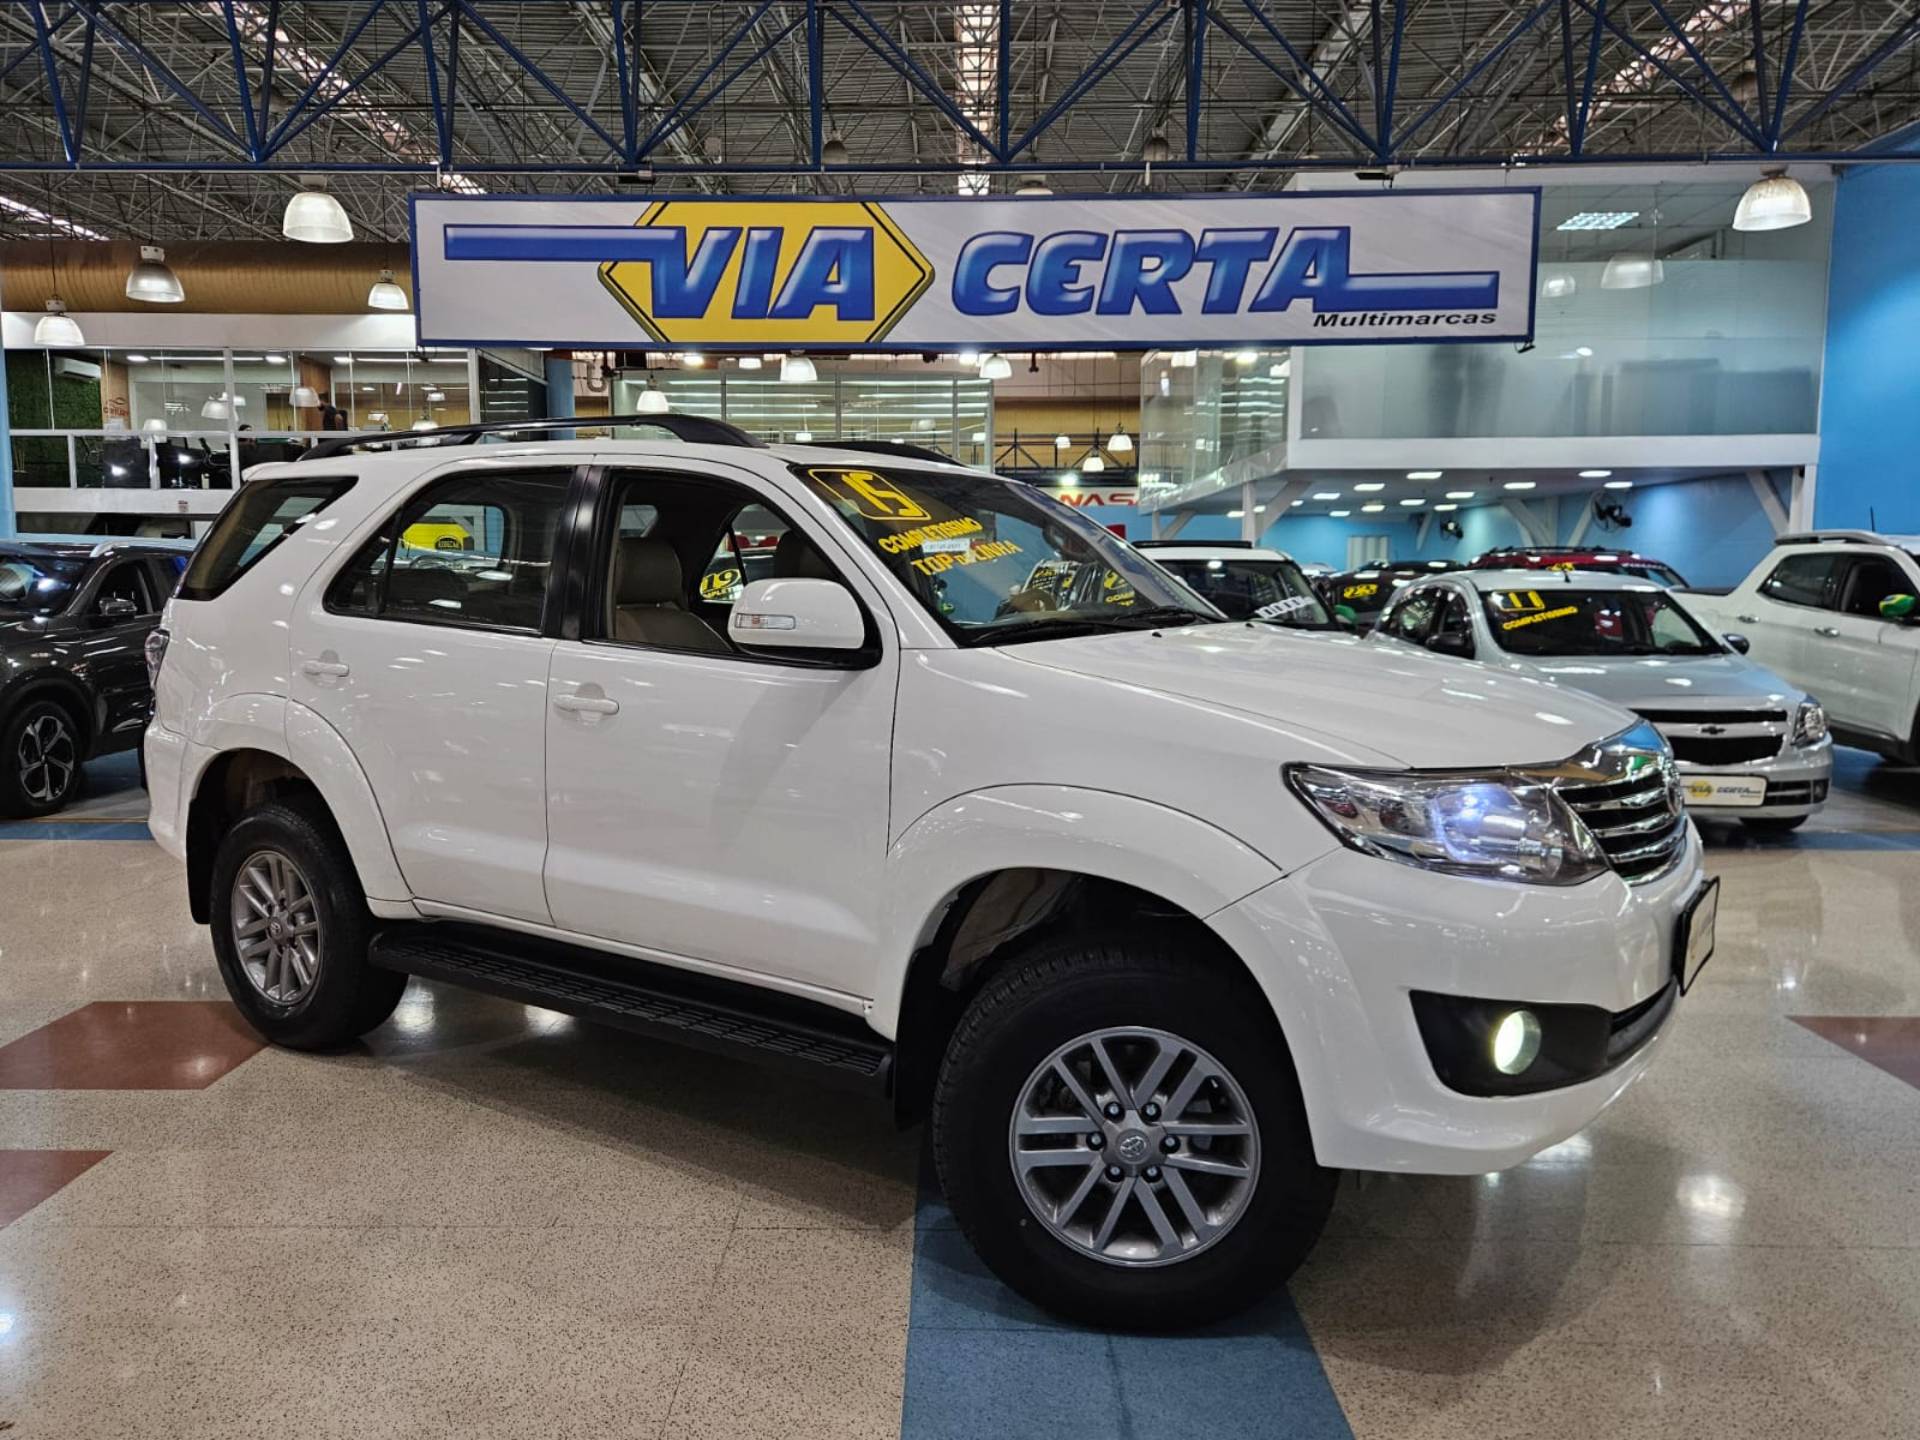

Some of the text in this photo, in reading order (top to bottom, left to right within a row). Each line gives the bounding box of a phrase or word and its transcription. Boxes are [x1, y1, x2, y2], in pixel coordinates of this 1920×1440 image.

[650, 225, 1351, 322] VIA CERTA
[1313, 312, 1497, 327] Multimarcas
[840, 472, 925, 517] 15
[878, 517, 983, 554] COMPLETISSIMO
[910, 553, 953, 576] TOP
[972, 540, 1024, 561] LINHA
